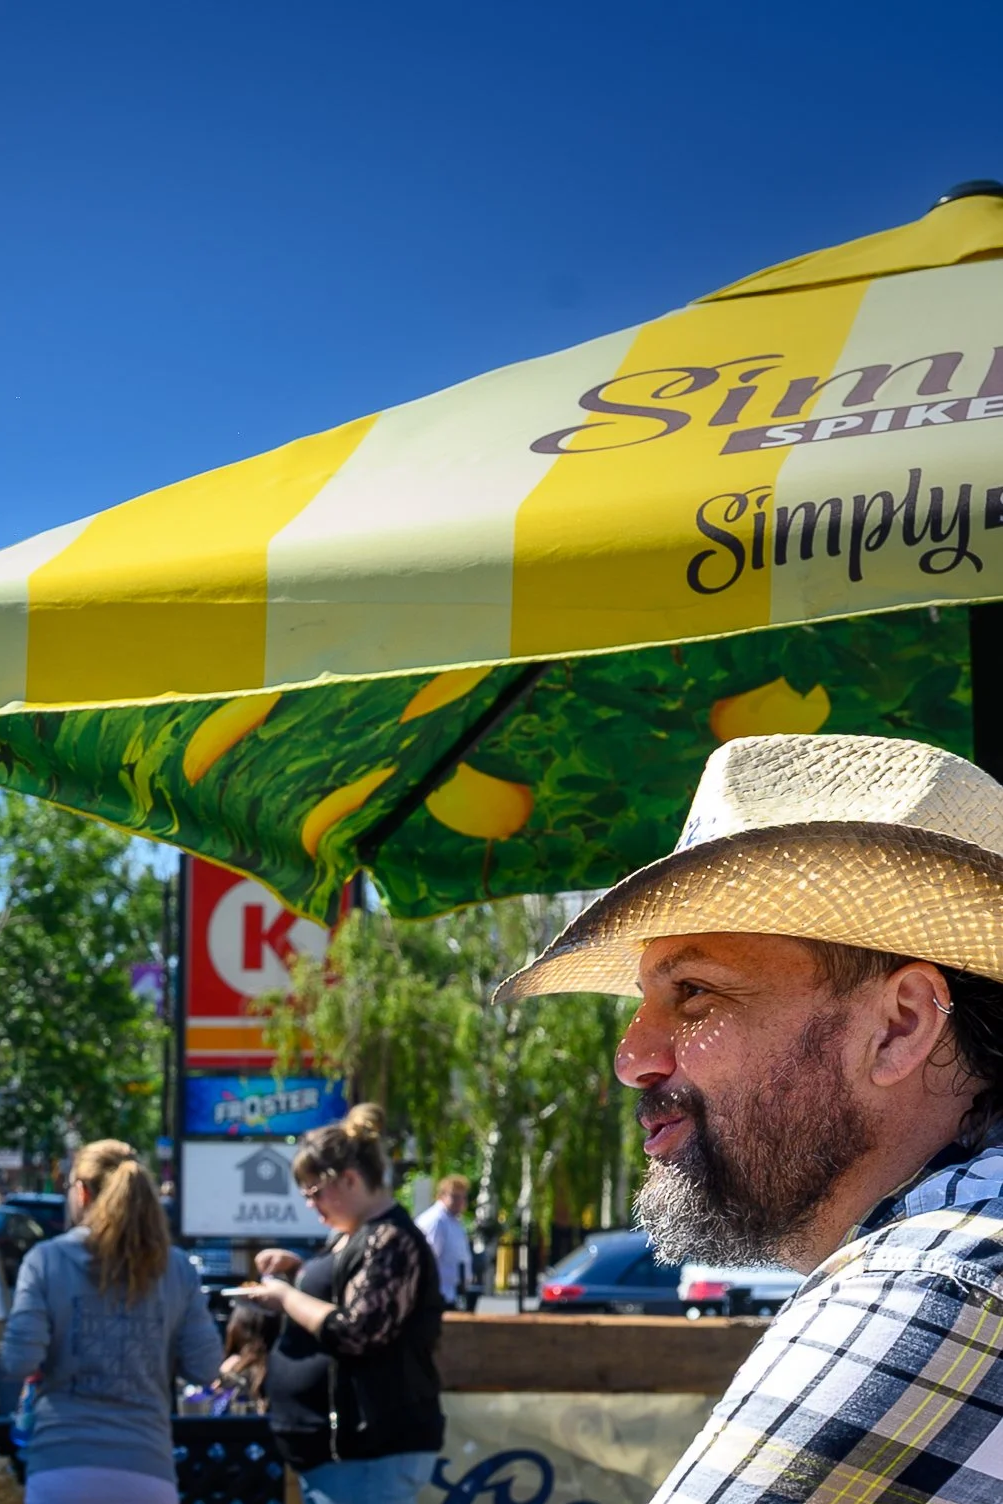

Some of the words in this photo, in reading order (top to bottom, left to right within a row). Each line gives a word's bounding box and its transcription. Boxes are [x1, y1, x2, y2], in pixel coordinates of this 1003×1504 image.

[529, 346, 1003, 455] Sim
[687, 468, 983, 595] Simply
[243, 904, 297, 971] K
[214, 1088, 319, 1124] FROSTER
